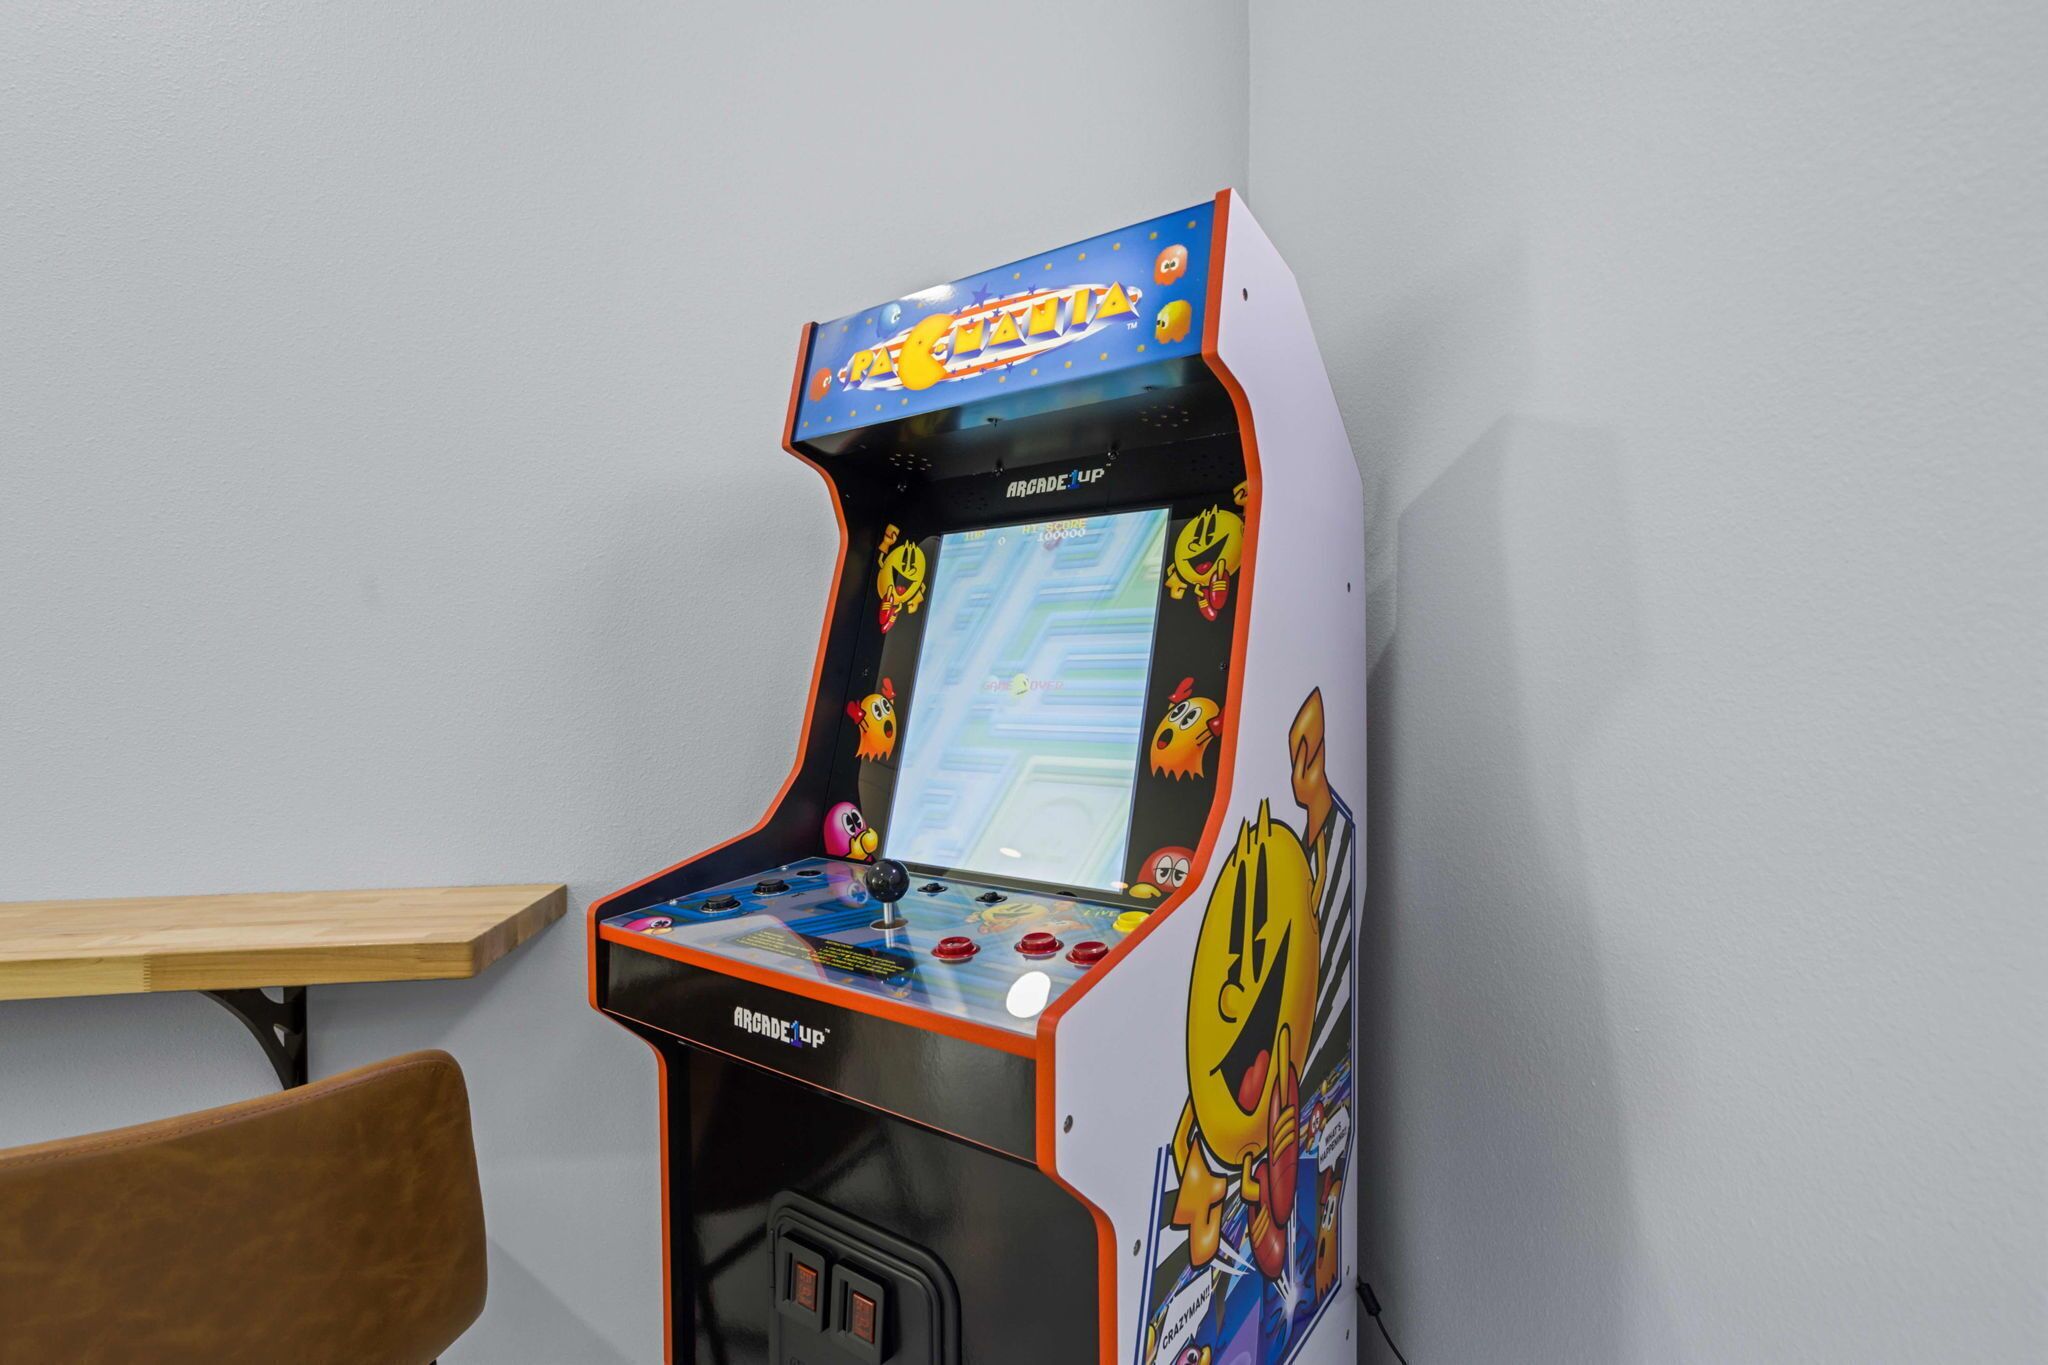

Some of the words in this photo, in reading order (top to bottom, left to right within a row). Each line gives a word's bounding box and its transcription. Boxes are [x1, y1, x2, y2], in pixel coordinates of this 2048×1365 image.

[1006, 468, 1105, 498] ARCADE1UP
[733, 1006, 825, 1048] ARCADE1UP
[1162, 1285, 1211, 1349] CRAZYMAN!!
